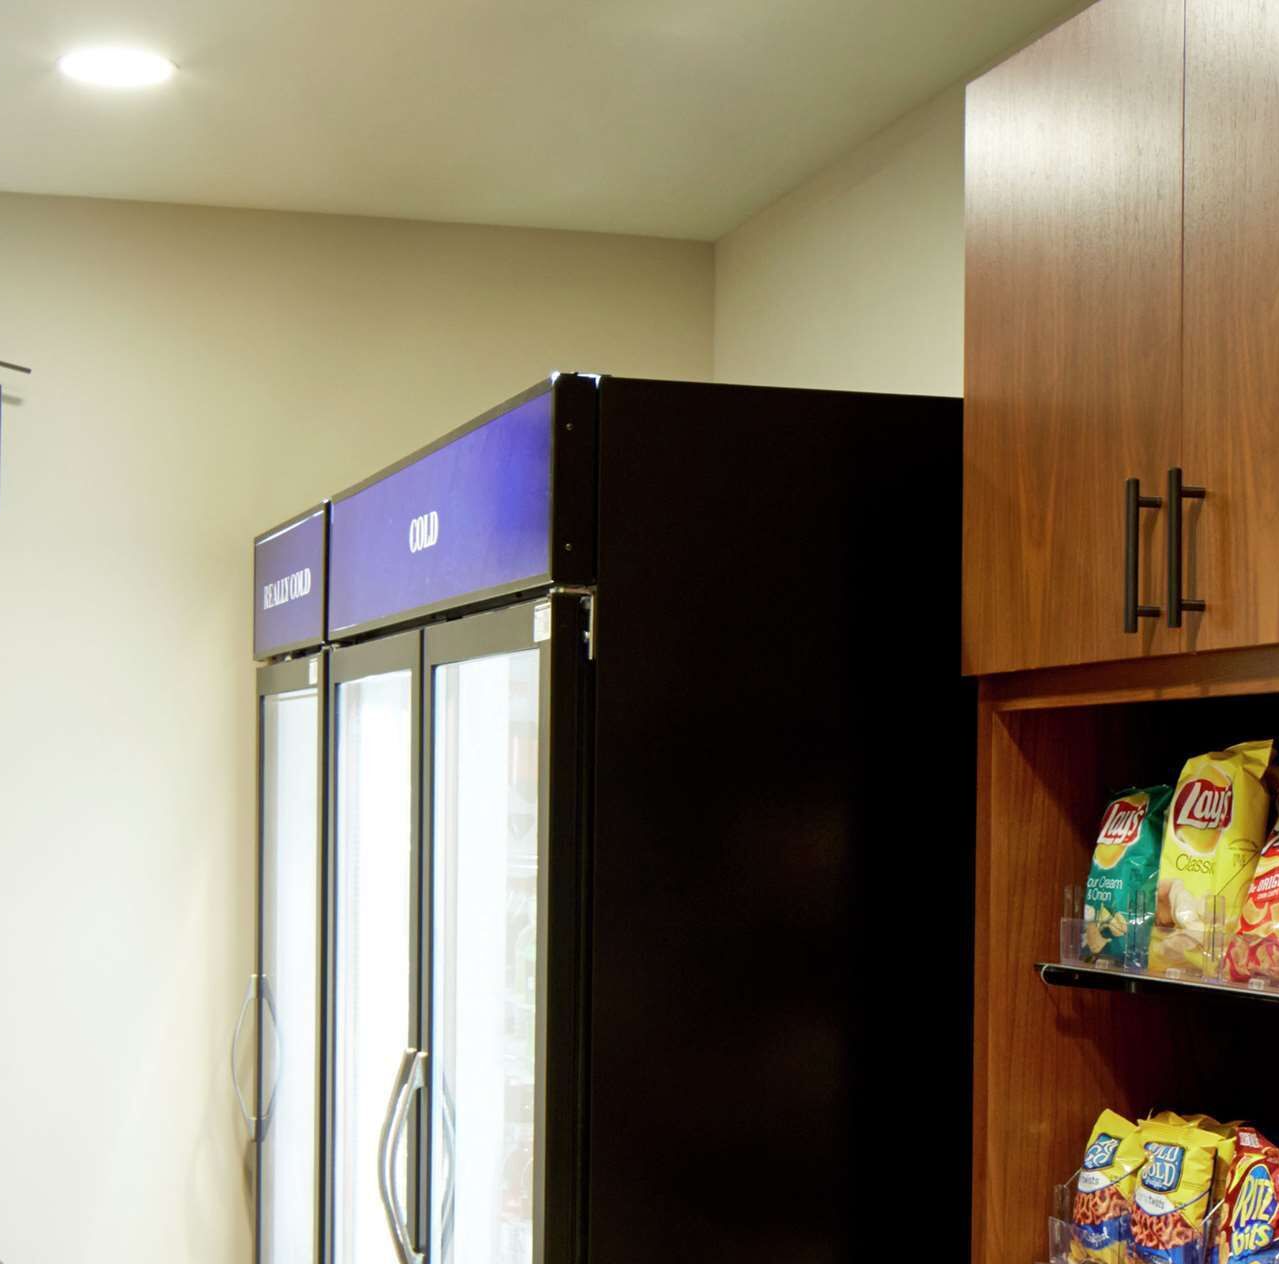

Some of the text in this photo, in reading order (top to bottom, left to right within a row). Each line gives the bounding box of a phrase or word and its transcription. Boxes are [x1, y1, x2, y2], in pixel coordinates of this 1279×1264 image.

[409, 511, 440, 553] COLD
[263, 567, 312, 610] REALLY COLD
[1096, 803, 1146, 845] Lay's
[1176, 782, 1233, 830] Lay's
[1092, 888, 1112, 901] Onion
[1098, 875, 1124, 890] Cream
[1231, 1174, 1279, 1229] RITZ
[1231, 1223, 1273, 1256] bits
